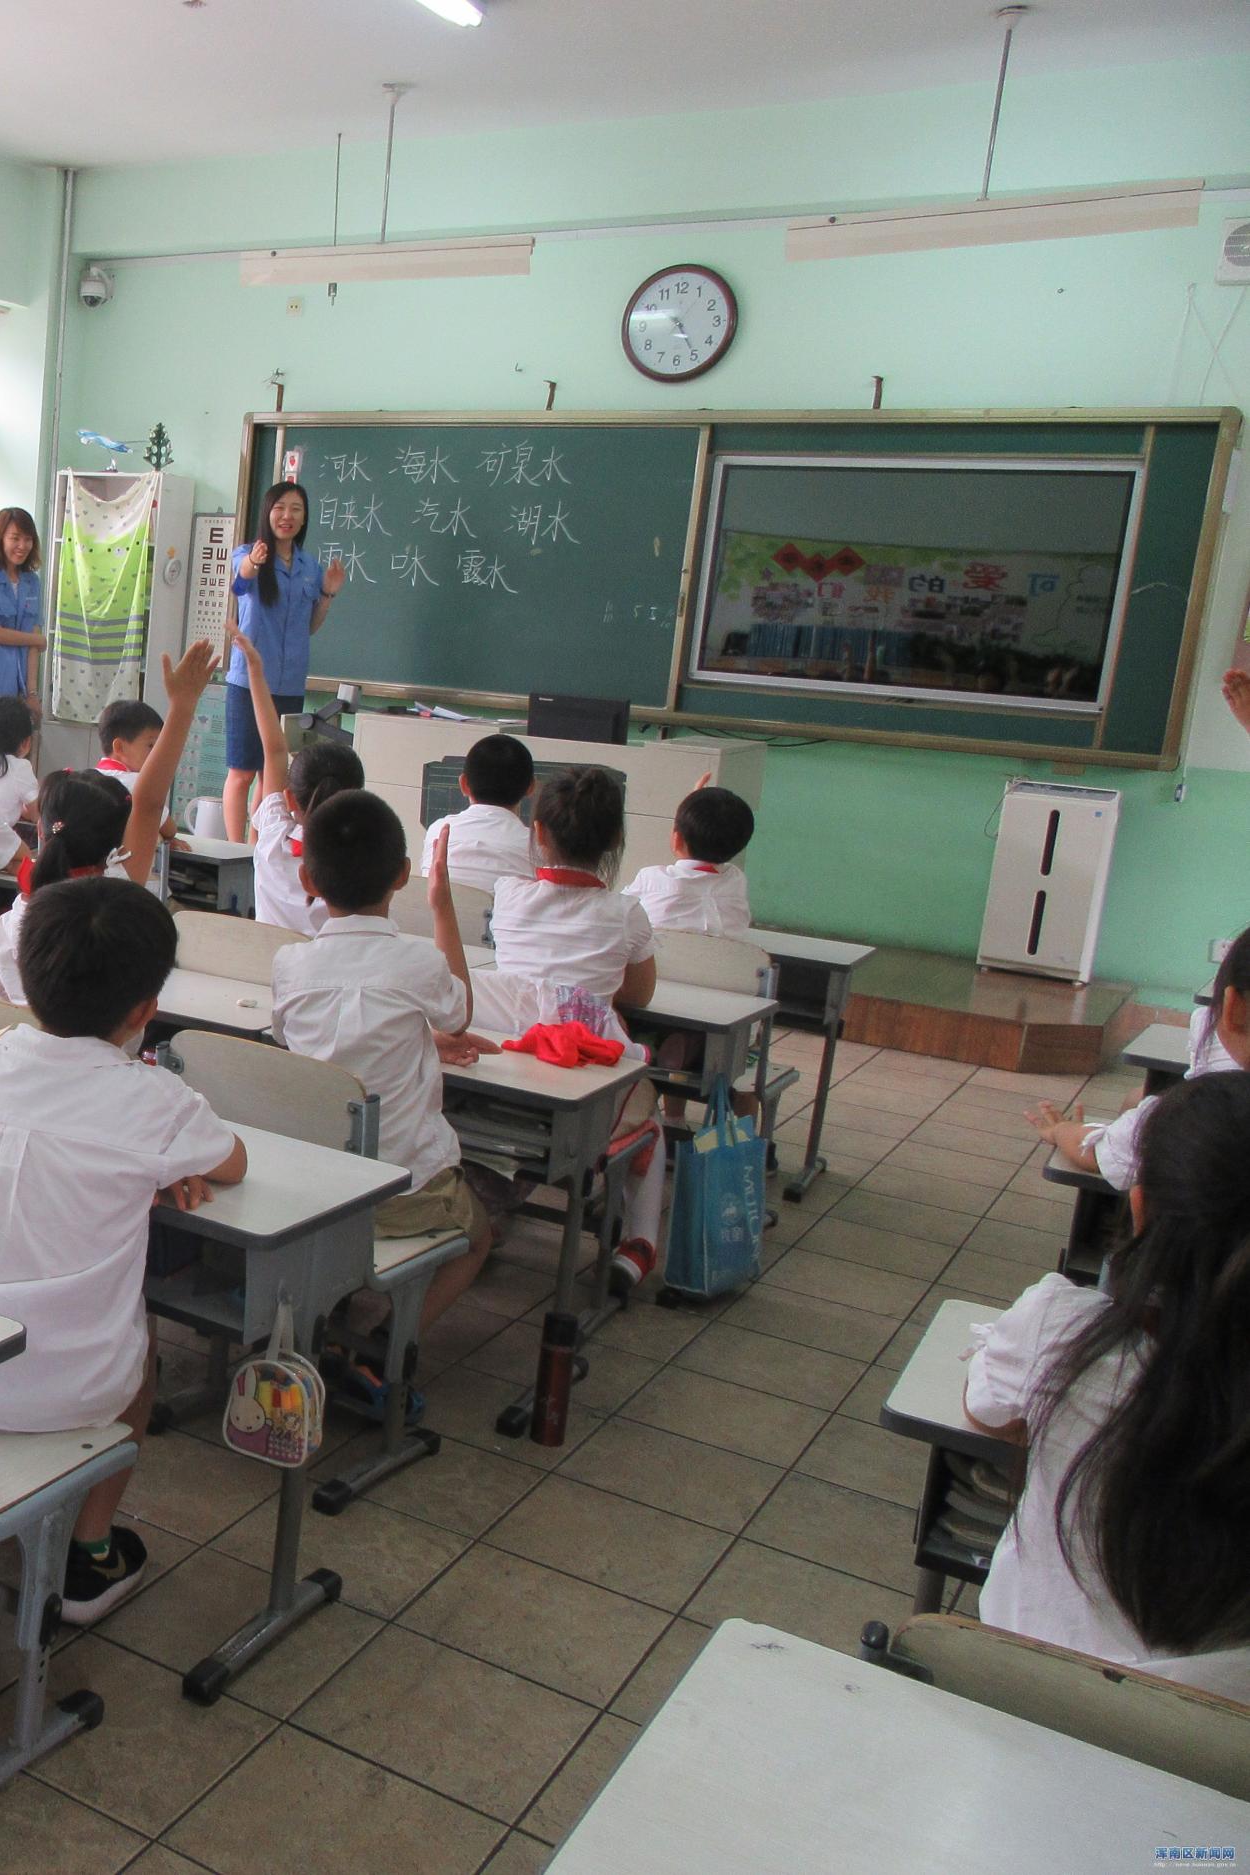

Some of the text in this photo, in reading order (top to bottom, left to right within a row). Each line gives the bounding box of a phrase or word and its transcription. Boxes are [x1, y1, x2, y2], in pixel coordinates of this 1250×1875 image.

[675, 282, 690, 294] 12
[697, 286, 703, 298] 1
[659, 289, 670, 301] 11
[707, 299, 716, 311] 2
[639, 321, 647, 333] 9
[712, 315, 721, 327] 3
[644, 339, 653, 351] 8
[705, 335, 713, 346] 4
[657, 351, 666, 363] 7
[673, 355, 680, 366] 6
[690, 350, 699, 361] 5
[318, 439, 573, 487] 河水 海水 矿泉水
[318, 493, 582, 546] 自来水 汽水 湖水
[318, 540, 519, 594] 雨水 口水 露水
